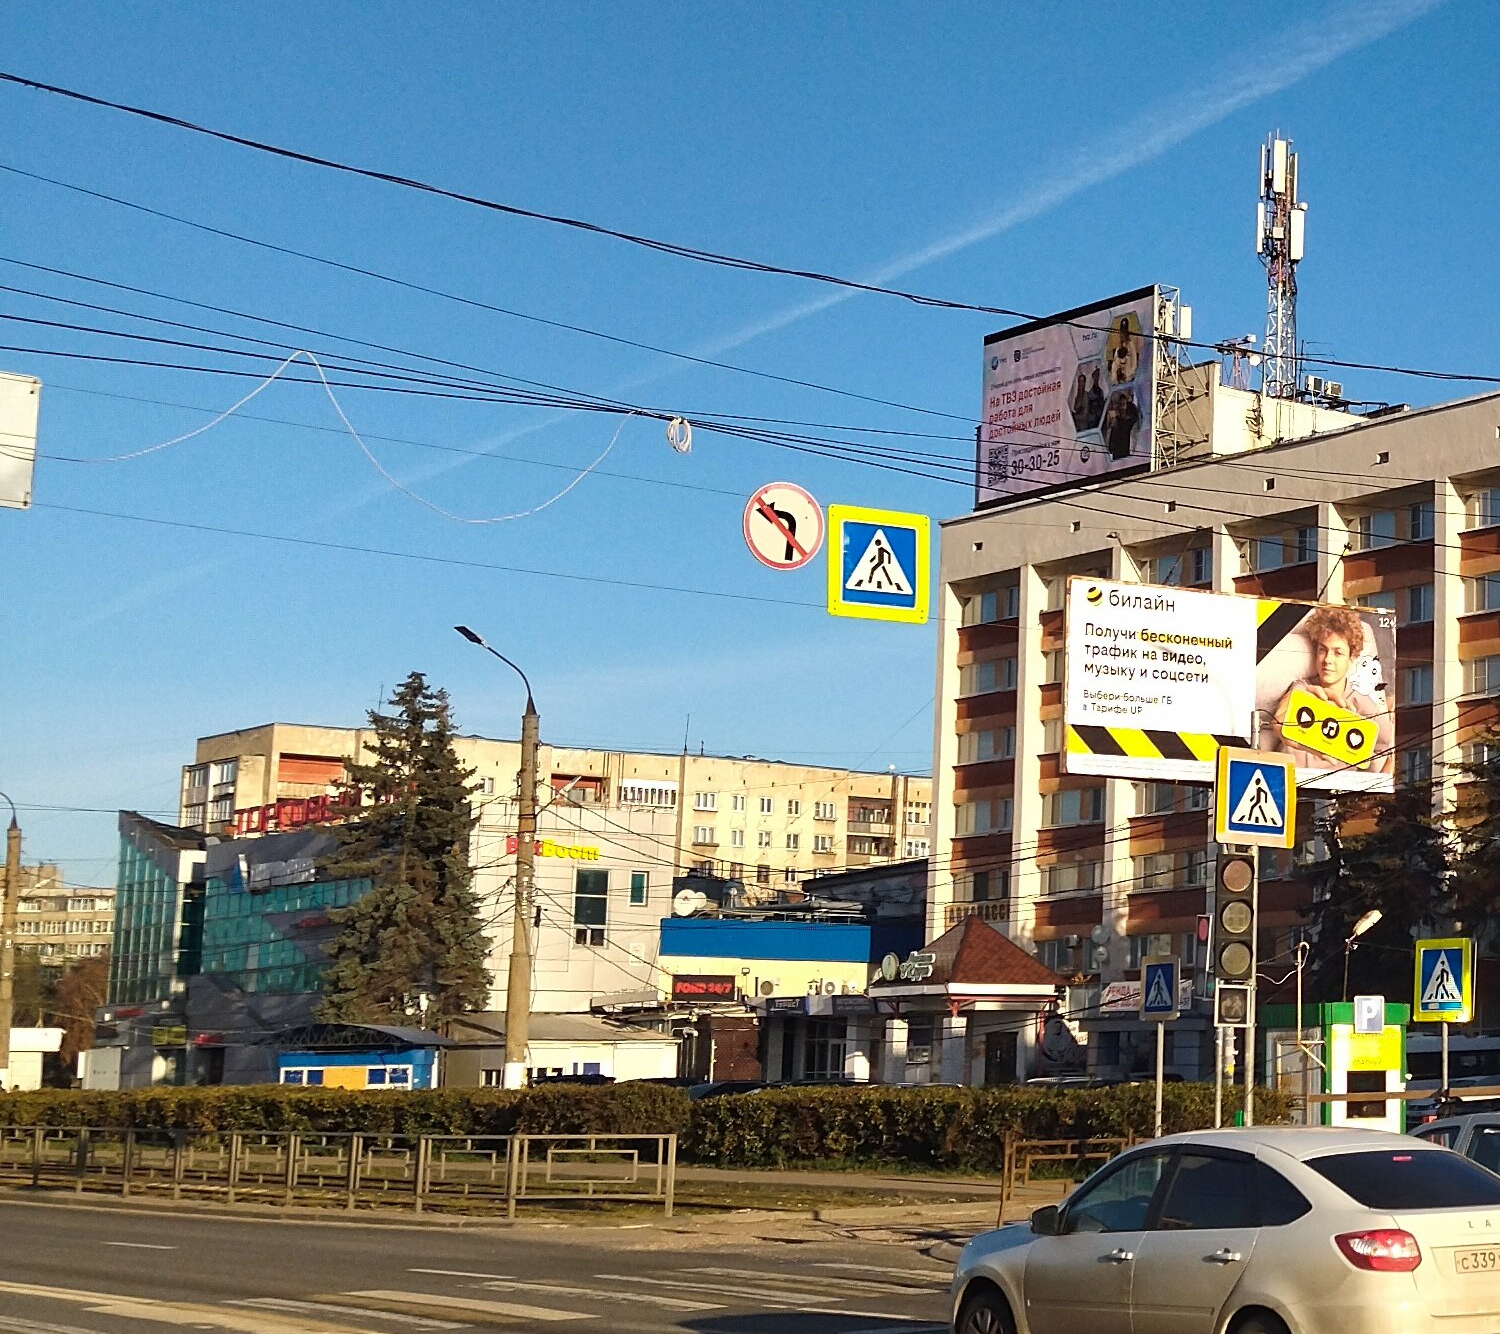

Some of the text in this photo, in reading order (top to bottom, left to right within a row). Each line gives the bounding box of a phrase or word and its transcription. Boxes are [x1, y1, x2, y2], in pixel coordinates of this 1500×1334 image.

[989, 396, 1000, 409] На
[1002, 390, 1017, 405] ТВЗ
[988, 403, 1034, 425] работа для
[1034, 409, 1061, 428] людей
[1011, 450, 1060, 477] 30-30-25
[1108, 589, 1175, 612] билайн
[1084, 622, 1234, 650] Получи бесконечный
[1084, 643, 1207, 666] трафик на видео,
[1084, 662, 1209, 684] музыку и соцсети
[1083, 689, 1121, 703] Выбери
[1123, 692, 1159, 705] больше
